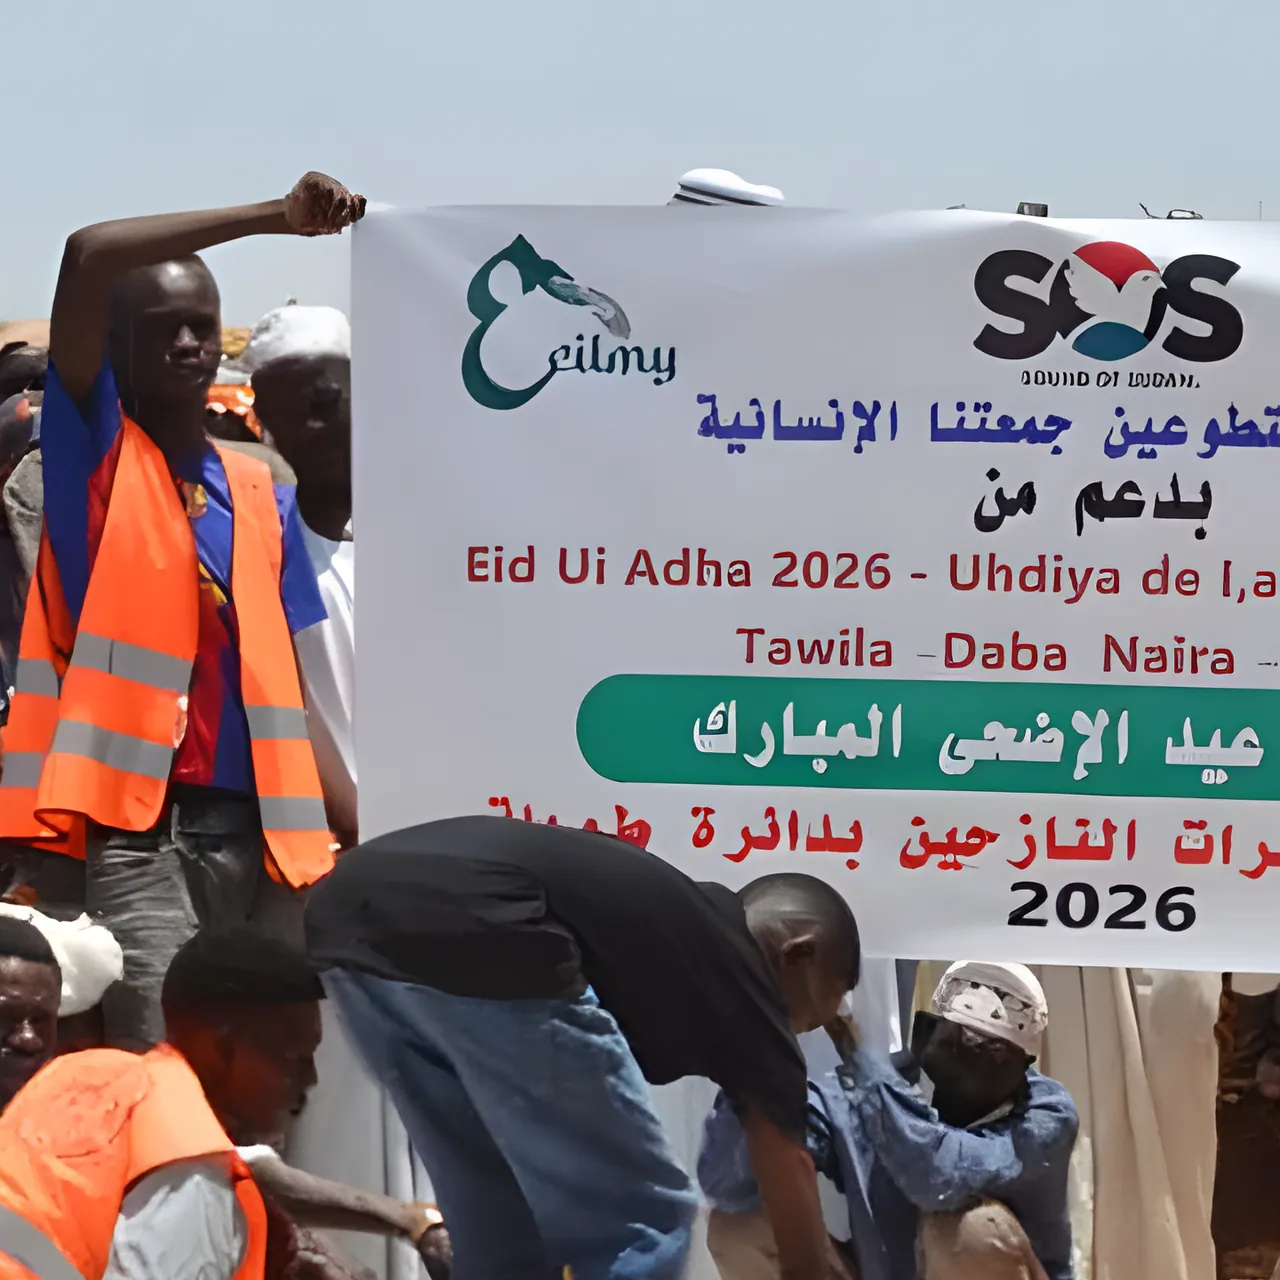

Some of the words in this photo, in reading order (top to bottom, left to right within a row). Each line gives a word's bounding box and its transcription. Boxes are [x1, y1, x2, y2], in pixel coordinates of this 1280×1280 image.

[973, 241, 1244, 363] SOS
[696, 393, 899, 455] الإنسانية
[930, 400, 1073, 456] جمعتنا
[973, 466, 1037, 533] من
[1075, 472, 1213, 541] بدعم
[467, 545, 535, 583] Eid
[624, 547, 752, 588] Adha
[771, 550, 891, 590] 2026
[949, 551, 1121, 605] Uhdiya
[1141, 553, 1201, 597] de
[735, 626, 893, 668] Tawila
[1103, 633, 1235, 676] Naira
[693, 699, 902, 774] المبارك
[1165, 716, 1265, 785] عيد
[690, 805, 864, 871] بدائرة
[899, 813, 1137, 872] النازحين
[1007, 881, 1196, 932] 2026
